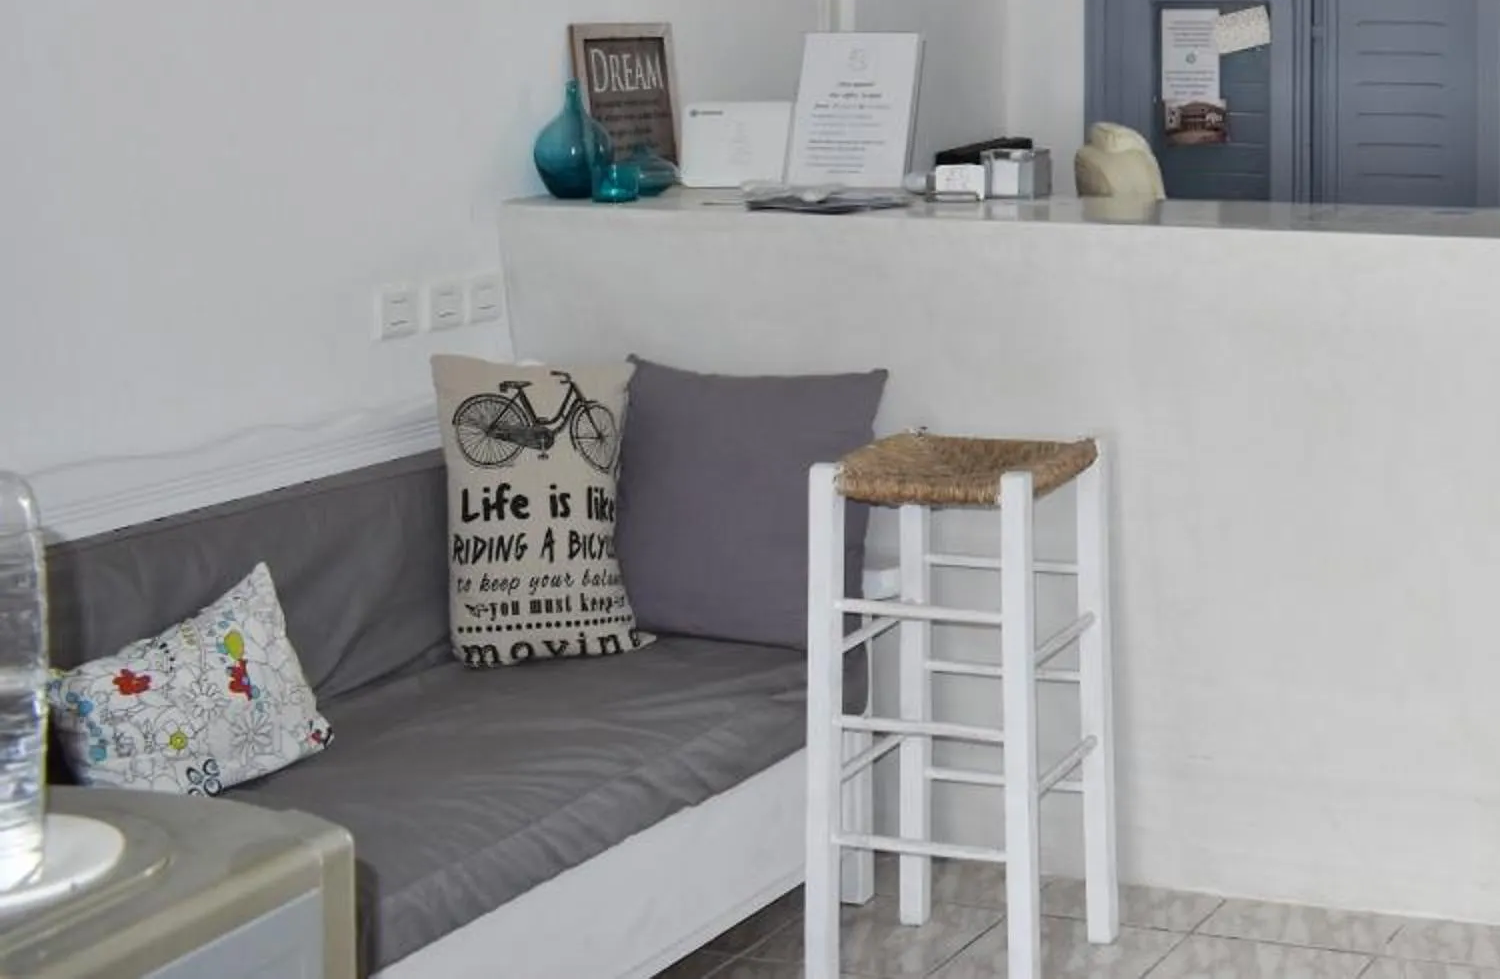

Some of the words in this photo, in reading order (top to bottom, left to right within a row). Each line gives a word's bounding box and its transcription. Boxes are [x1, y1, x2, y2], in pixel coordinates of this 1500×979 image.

[590, 48, 665, 92] DREAM
[461, 483, 530, 523] Life
[550, 484, 571, 518] is
[453, 533, 528, 565] RIDING
[540, 527, 555, 563] A
[457, 577, 472, 593] to
[479, 573, 521, 596] keep
[528, 572, 574, 595] your
[488, 600, 520, 621] you
[530, 595, 572, 615] must
[580, 593, 613, 613] keep
